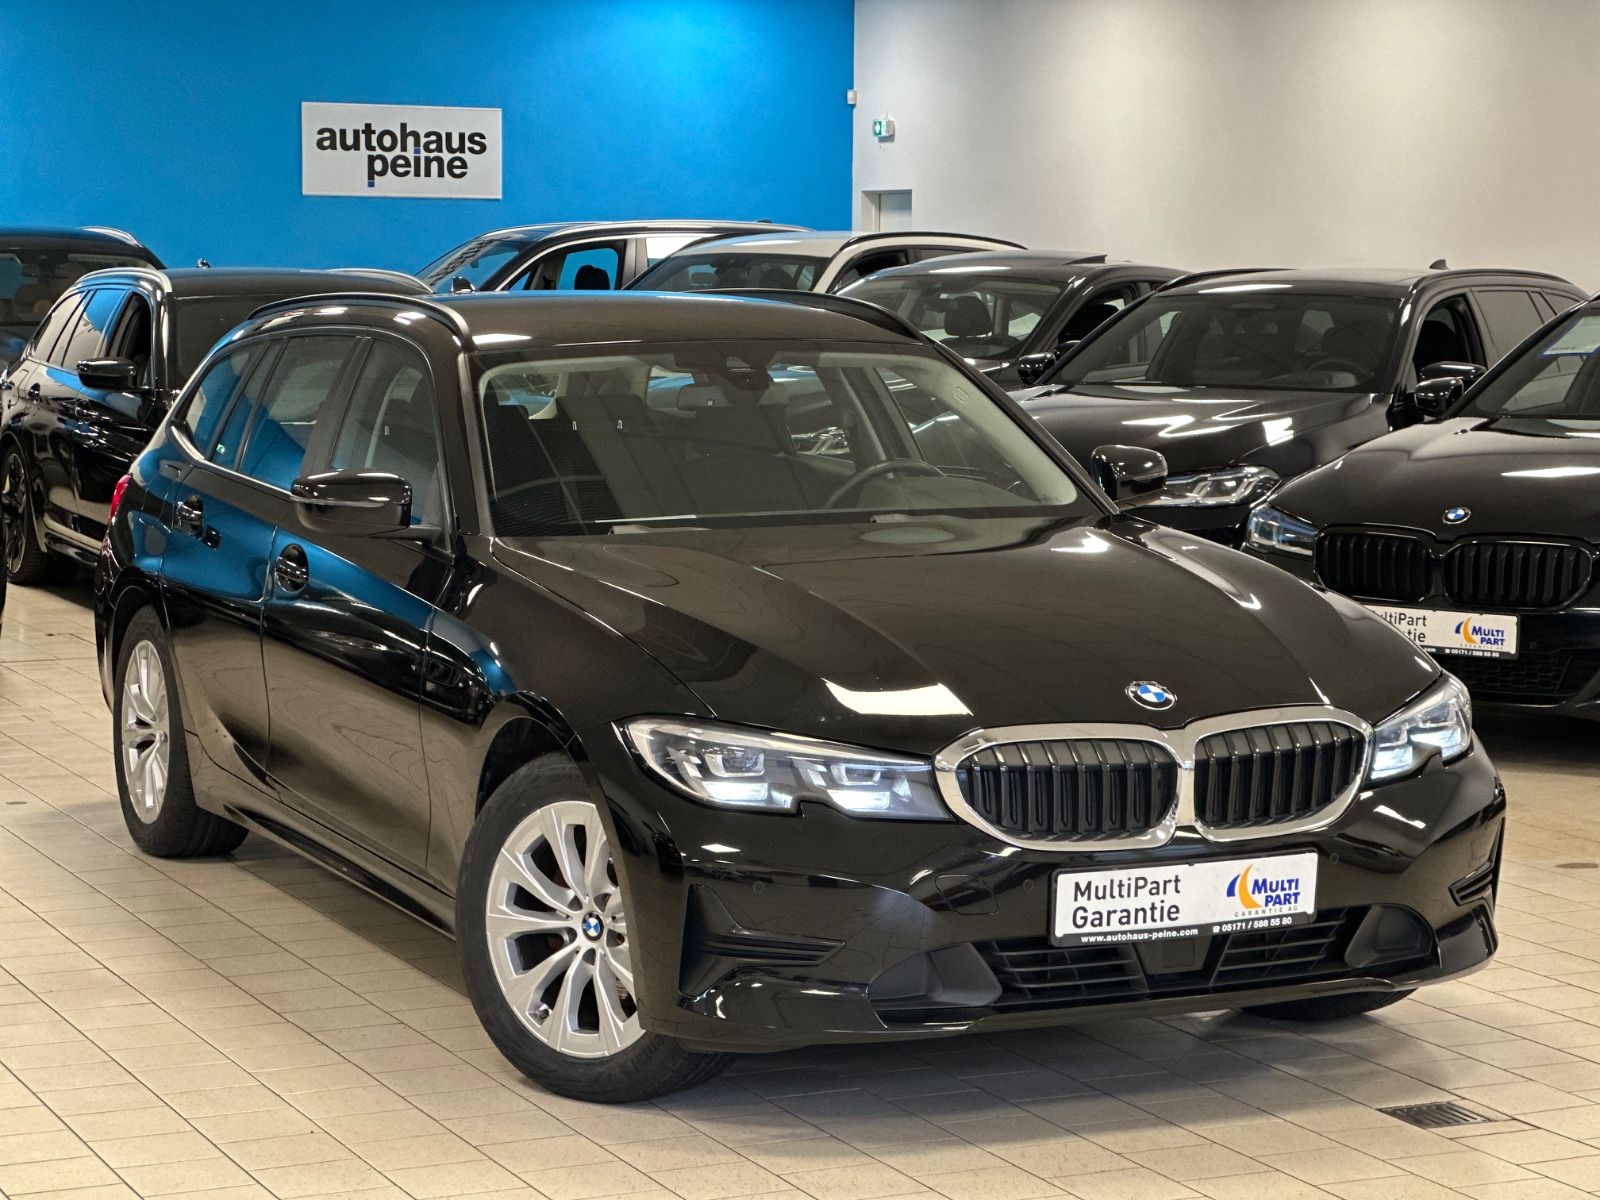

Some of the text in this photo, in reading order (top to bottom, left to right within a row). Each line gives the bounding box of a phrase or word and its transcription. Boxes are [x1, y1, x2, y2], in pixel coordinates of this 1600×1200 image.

[316, 122, 487, 155] autohaus
[367, 147, 469, 188] peine
[1373, 611, 1428, 627] ltiPart
[1471, 625, 1505, 638] MULTI
[1480, 636, 1506, 646] PART
[1073, 874, 1181, 902] MultiPart
[1251, 877, 1300, 895] MULTI
[1264, 891, 1301, 907] PART
[1072, 899, 1180, 929] Garantie
[1234, 907, 1283, 918] GARANTIE
[1221, 921, 1246, 932] 05171
[1080, 928, 1199, 943] www.autohaus-peine.com
